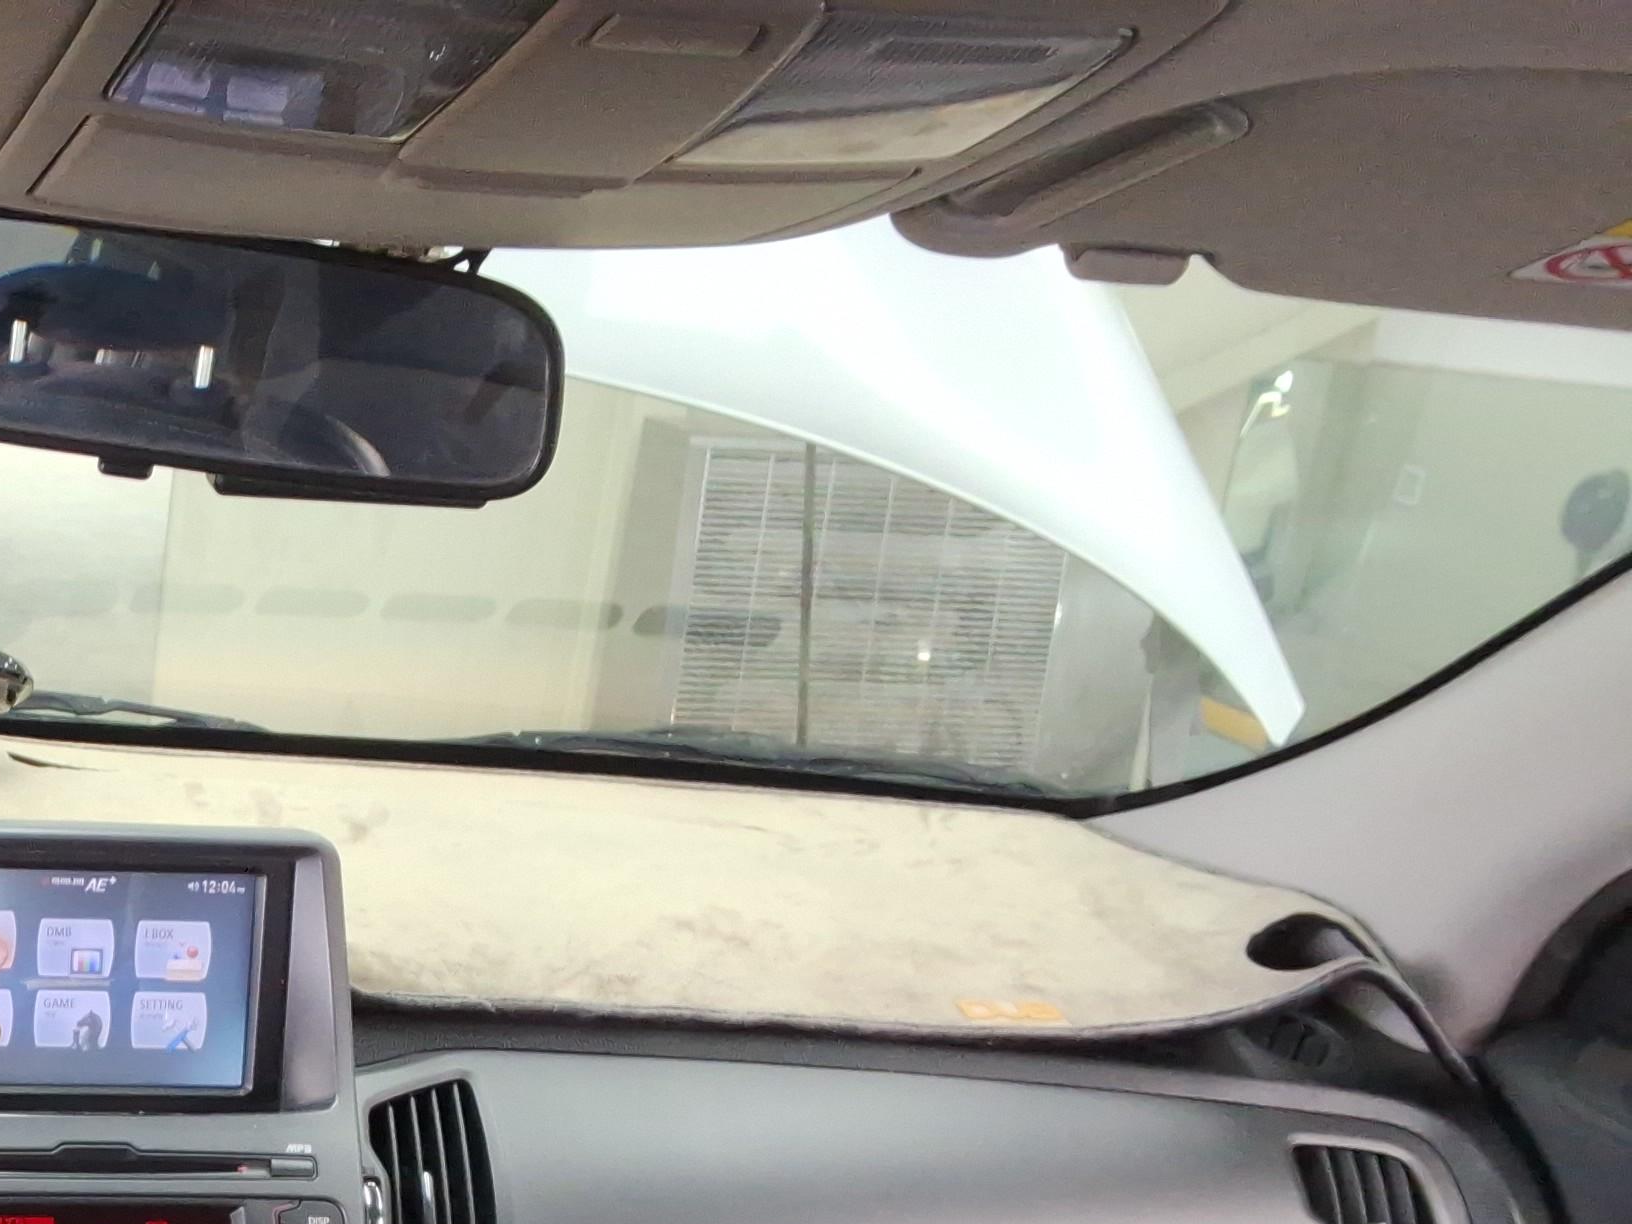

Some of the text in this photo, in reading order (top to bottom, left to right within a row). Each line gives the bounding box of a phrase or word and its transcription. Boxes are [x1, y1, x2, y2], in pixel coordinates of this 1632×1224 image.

[201, 879, 236, 894] 12:04
[46, 927, 72, 937] DMB
[43, 998, 74, 1009] GAME
[140, 999, 183, 1010] SETTING
